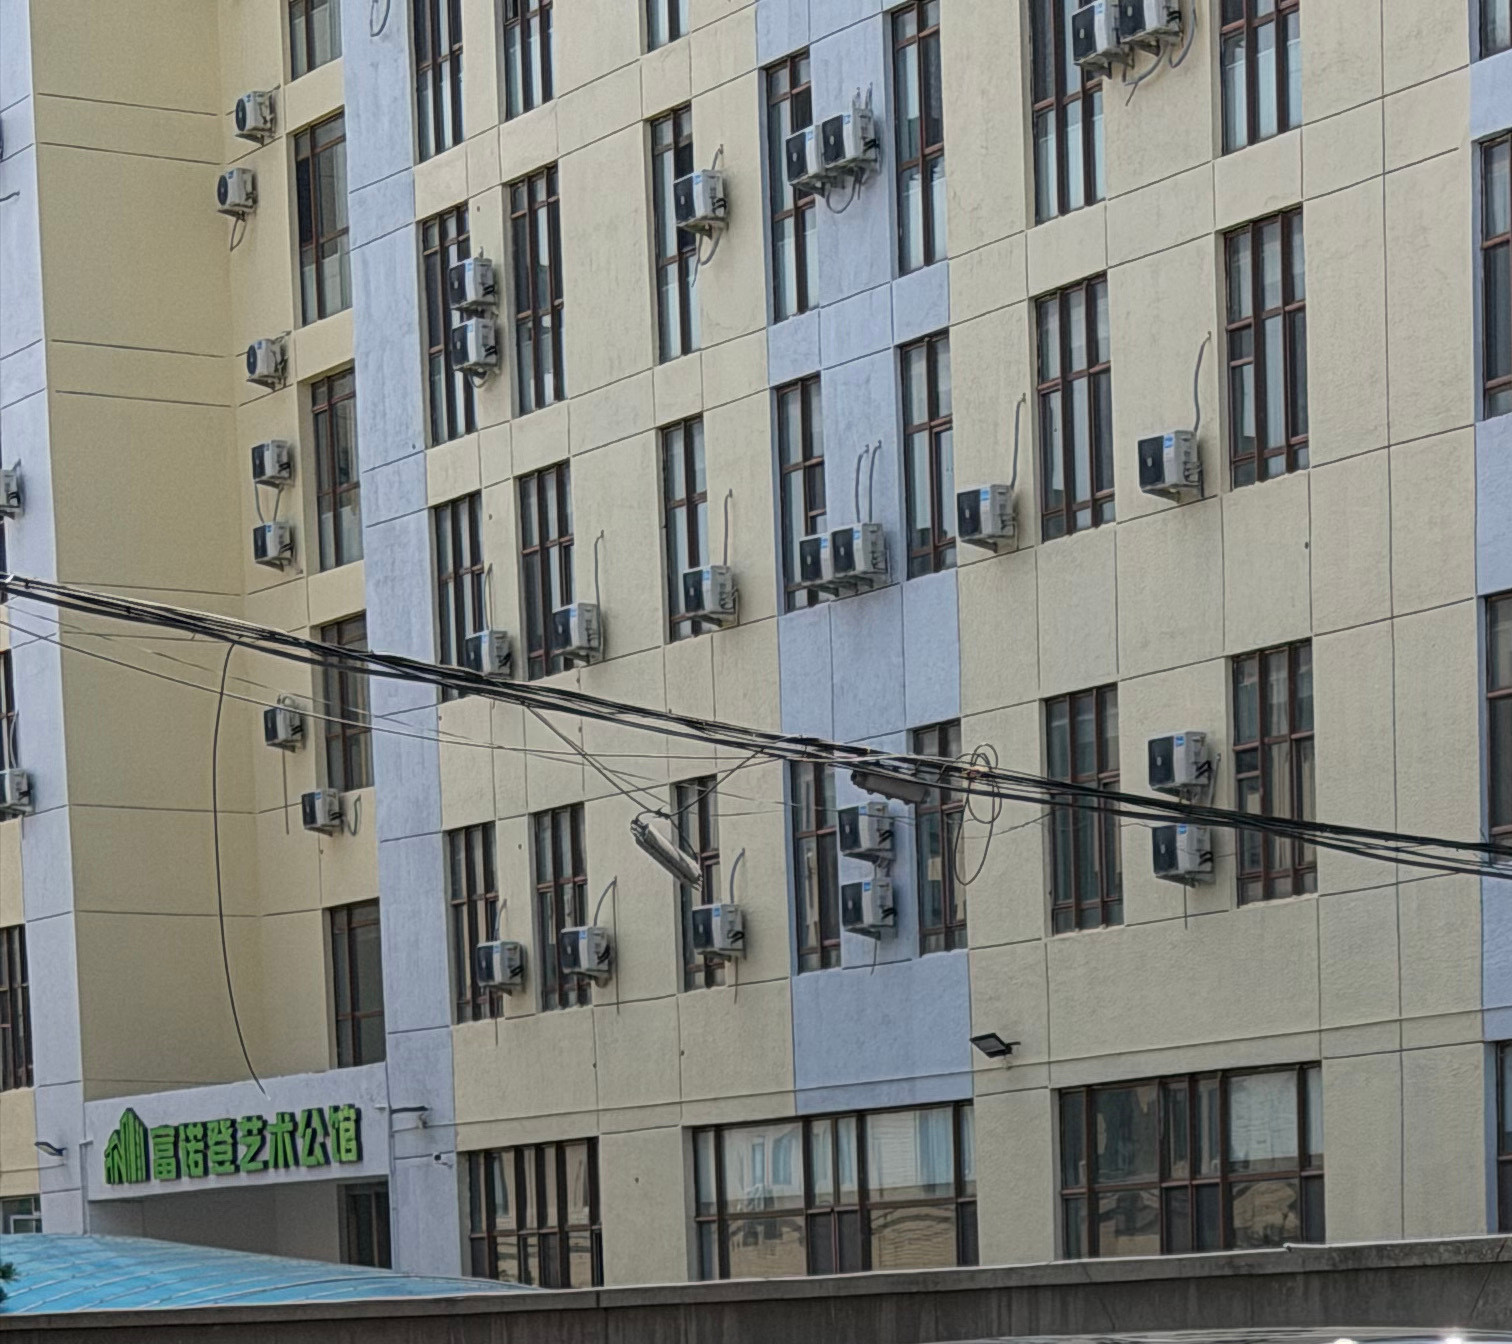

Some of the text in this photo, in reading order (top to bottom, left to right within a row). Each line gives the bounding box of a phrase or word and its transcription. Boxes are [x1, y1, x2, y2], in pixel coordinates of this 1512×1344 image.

[150, 1104, 361, 1180] 富诺登艺术公馆
